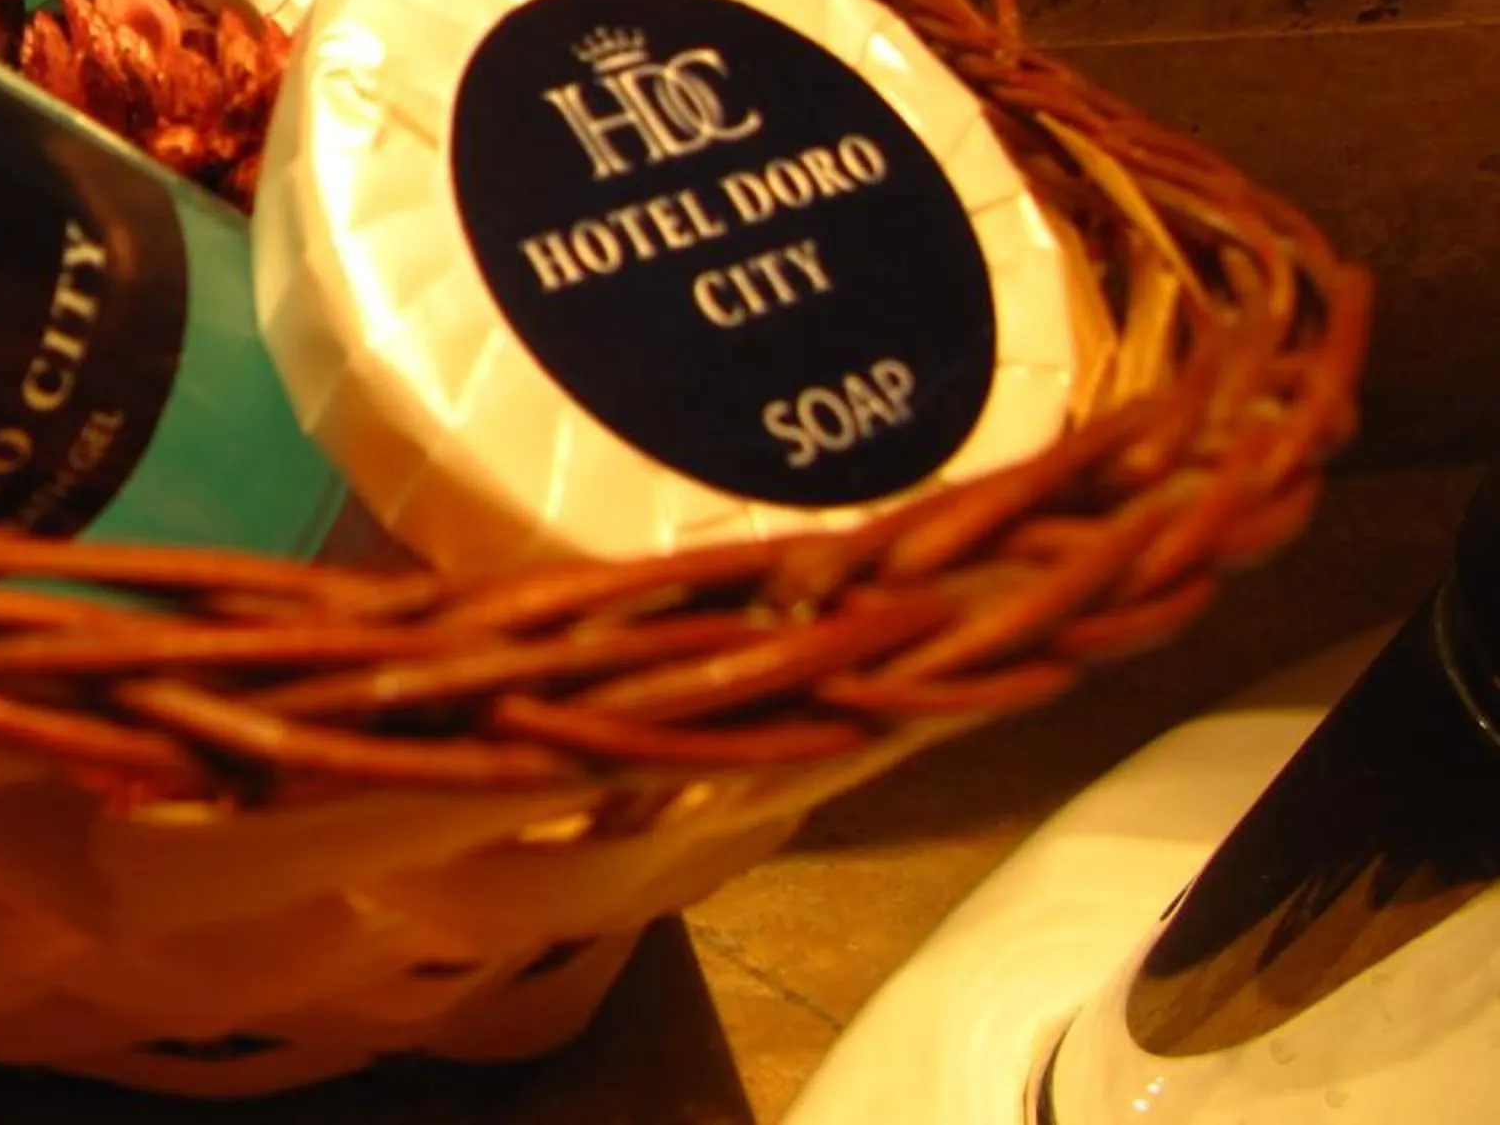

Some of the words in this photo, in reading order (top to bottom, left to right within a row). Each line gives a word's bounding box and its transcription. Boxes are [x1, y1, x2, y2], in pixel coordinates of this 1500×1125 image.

[518, 189, 726, 293] HOTEL
[720, 135, 888, 224] DORO
[21, 218, 106, 412] CITY
[692, 239, 835, 328] CITY
[762, 357, 917, 467] SOAP
